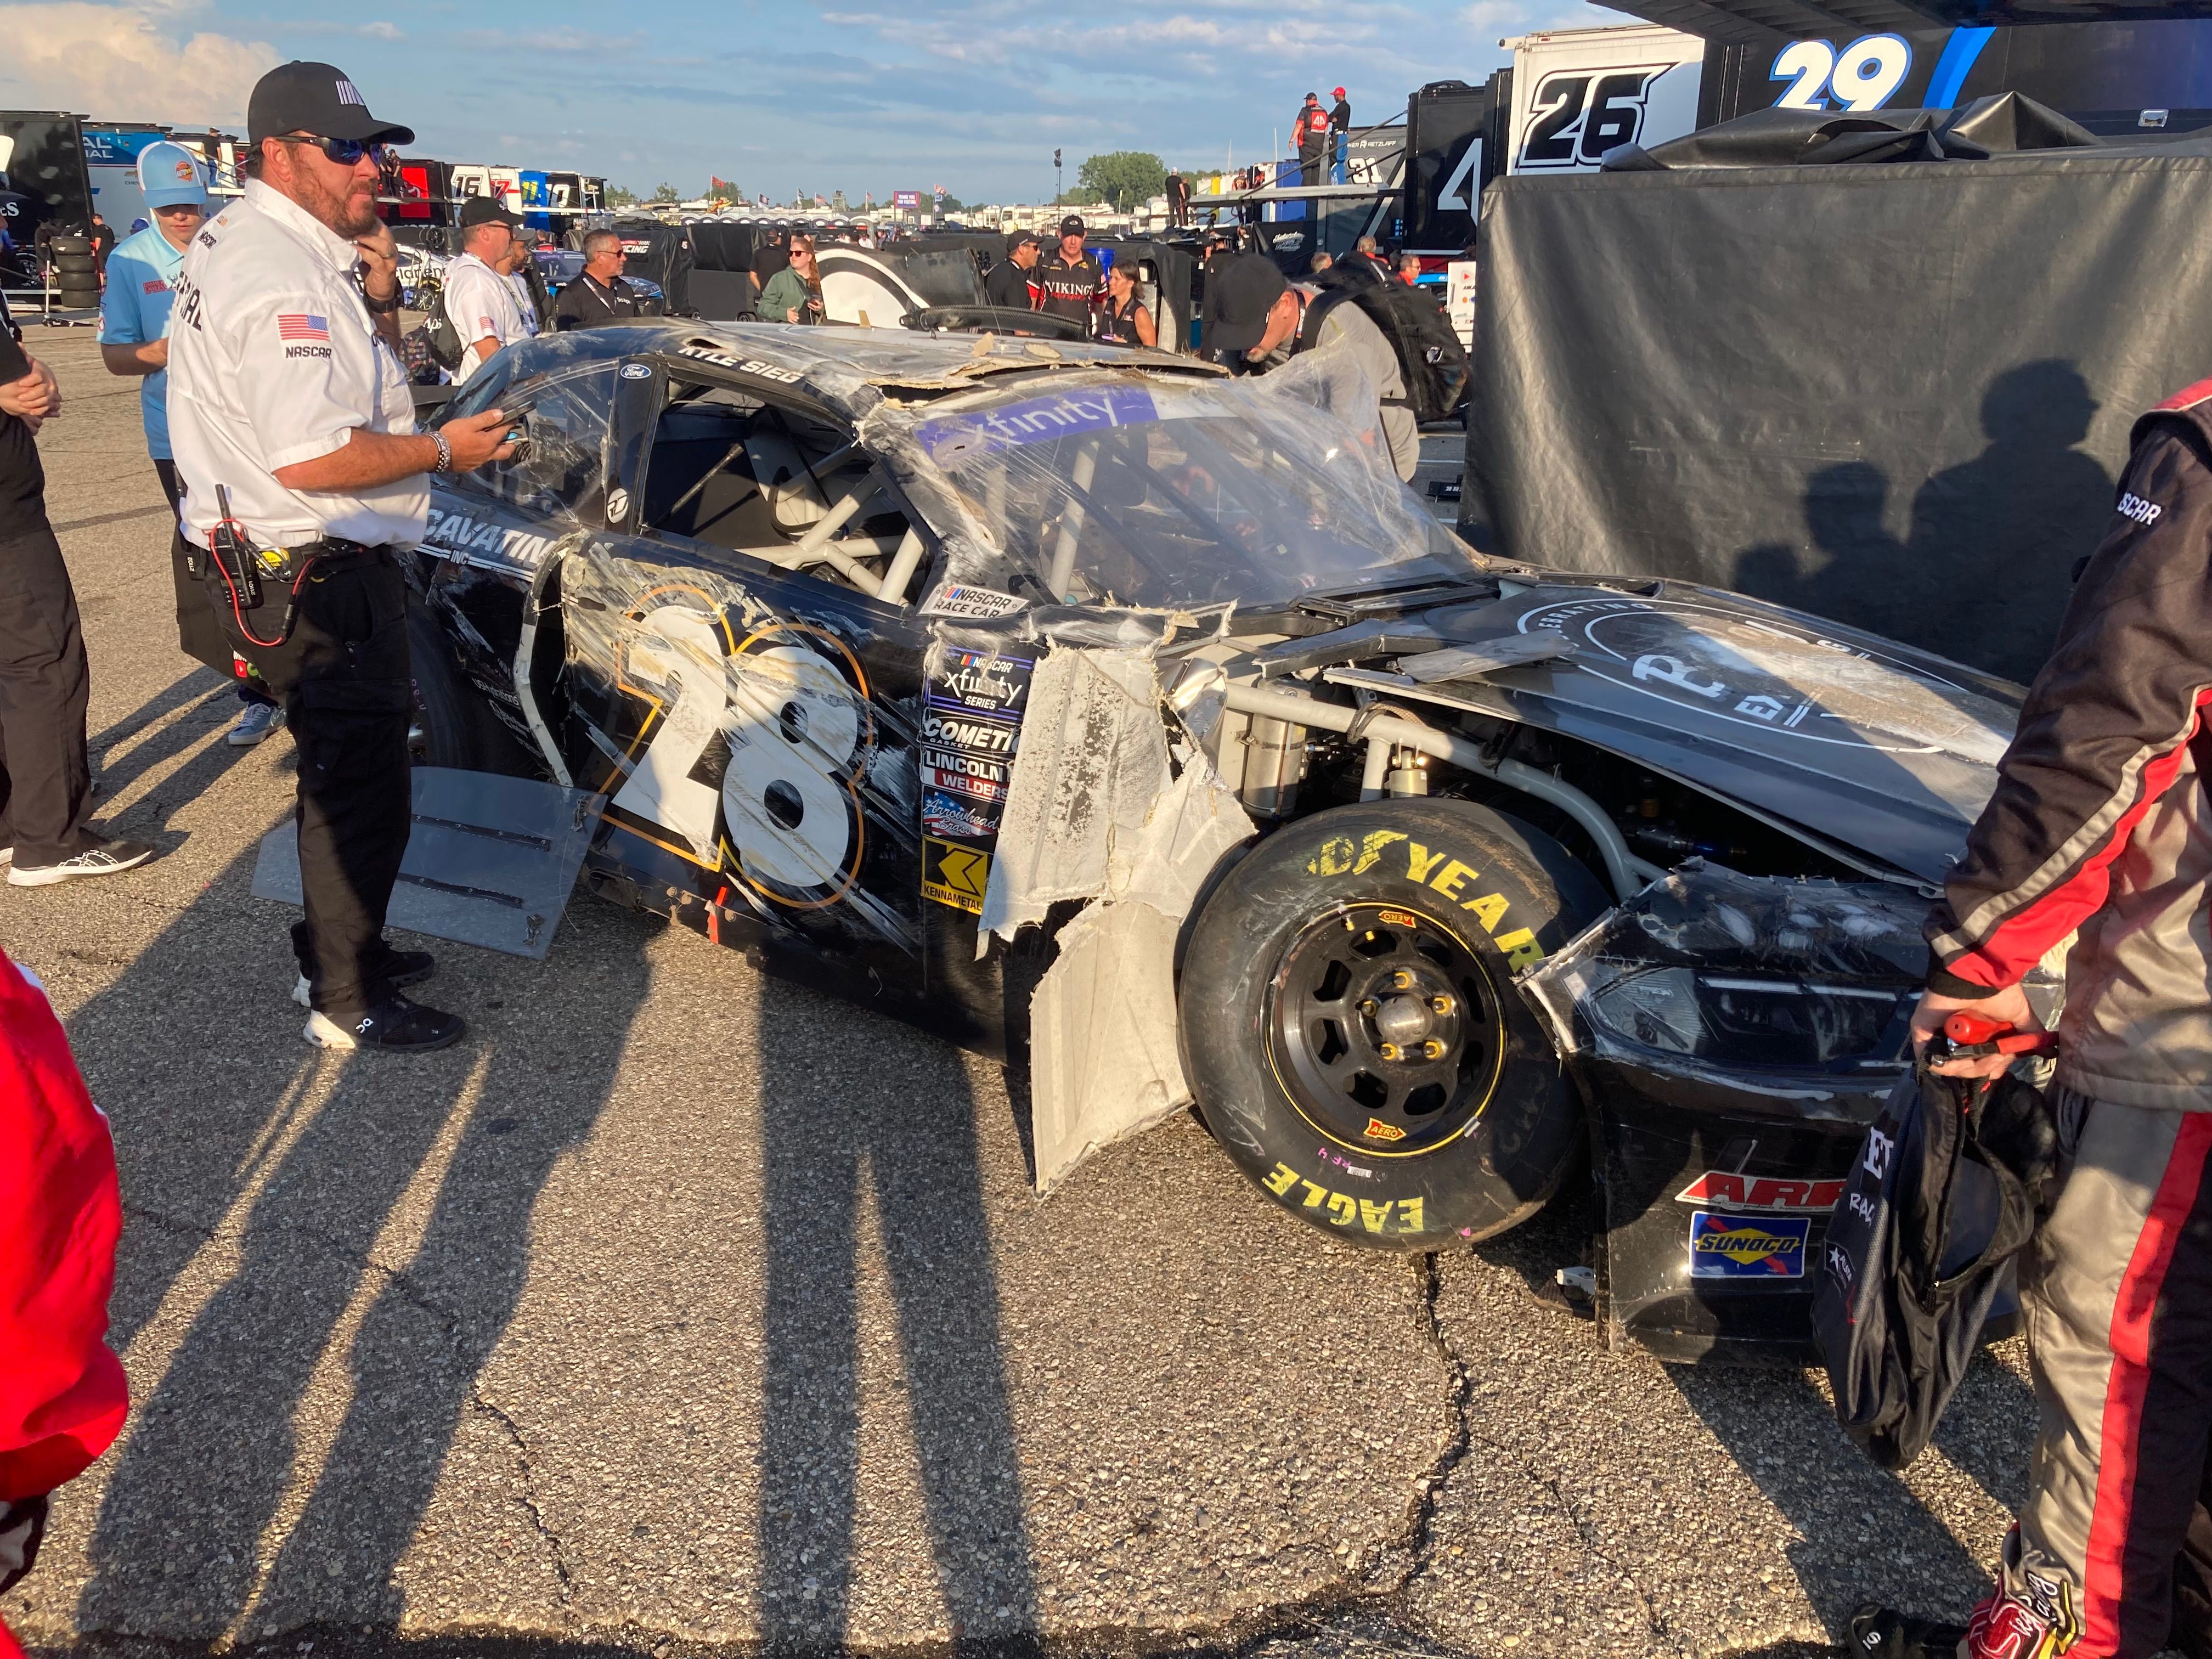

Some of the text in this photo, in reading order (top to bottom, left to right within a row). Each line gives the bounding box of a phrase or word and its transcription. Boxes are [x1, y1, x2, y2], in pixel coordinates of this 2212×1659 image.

[1770, 34, 1911, 110] 29
[1520, 67, 1651, 166] 26
[1347, 157, 1384, 184] 31
[452, 174, 482, 199] 16
[622, 245, 649, 253] ACING
[1045, 280, 1094, 296] VIKING
[285, 346, 332, 359] NASCAR
[624, 366, 645, 377] Ford
[740, 360, 805, 383] SIEG
[2117, 492, 2162, 526] SCAR
[425, 509, 557, 566] CAVATIN
[933, 600, 1000, 618] RACE CAR
[956, 588, 1012, 610] NASCAR
[964, 695, 997, 710] SERIES
[611, 605, 859, 888] 28
[929, 738, 970, 749] GASKET
[926, 751, 1003, 782] LINCOLN
[942, 773, 1009, 800] WELDERS
[922, 798, 1000, 830] Arrowhead
[939, 815, 972, 836] Brass
[924, 884, 982, 911] KENNAMETAL
[1370, 1126, 1398, 1138] AERO
[1262, 1160, 1425, 1234] EAGLE
[1701, 1235, 1798, 1252] SUNOCO
